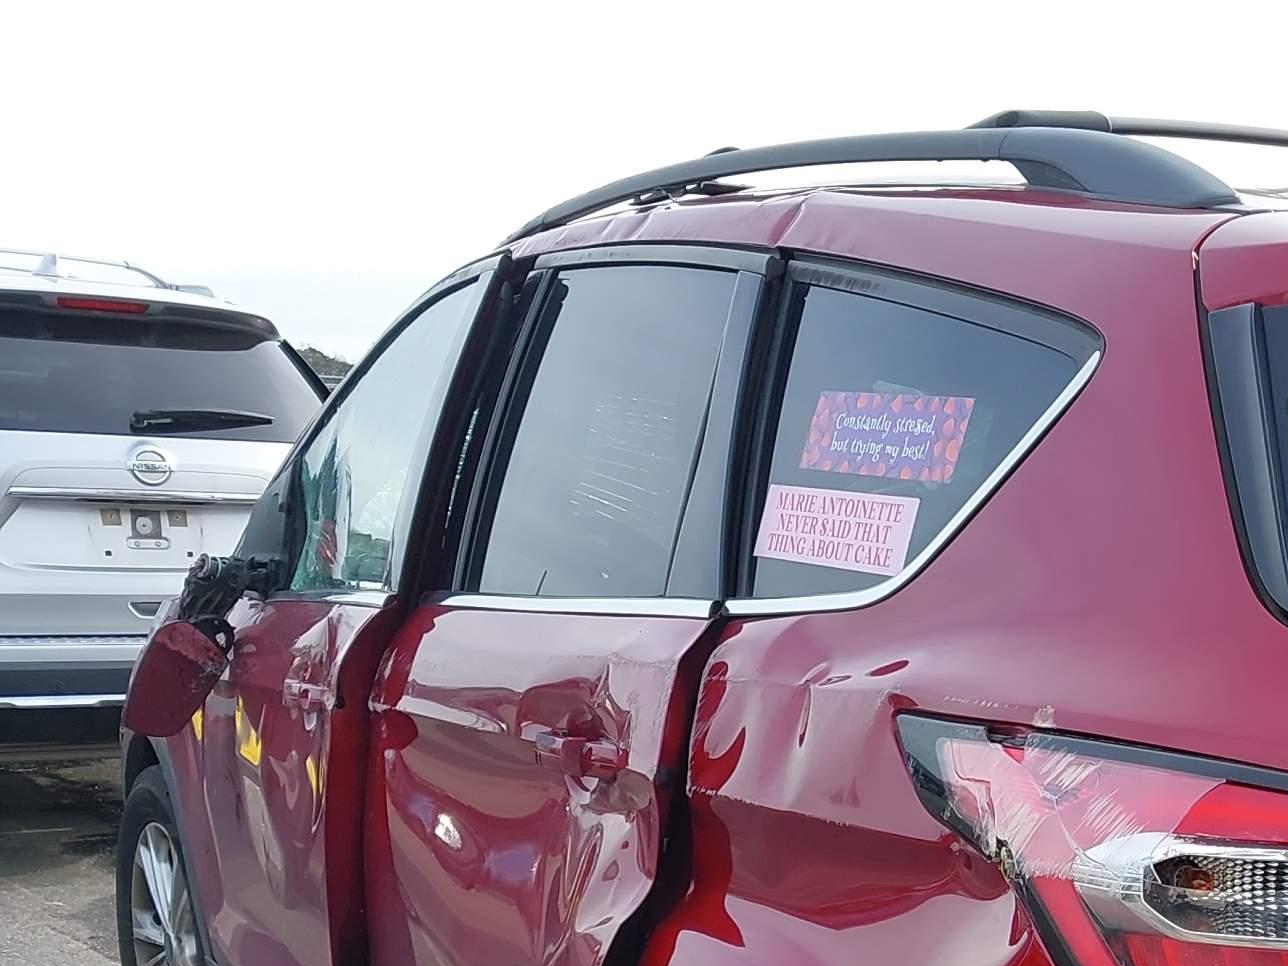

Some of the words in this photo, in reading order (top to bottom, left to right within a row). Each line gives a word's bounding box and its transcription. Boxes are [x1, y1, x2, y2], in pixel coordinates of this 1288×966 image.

[835, 412, 892, 439] Constantly
[830, 431, 849, 453] but
[850, 437, 883, 463] trying
[885, 444, 900, 464] my
[901, 436, 930, 460] best!
[776, 491, 818, 513] MARIE
[817, 495, 904, 523] ANTOINETTE
[776, 512, 818, 535] NEVER
[819, 517, 851, 539] SAID
[851, 521, 893, 545] THAT
[767, 532, 806, 555] THING
[806, 538, 853, 562] ABOUT
[854, 544, 893, 568] CAKE
